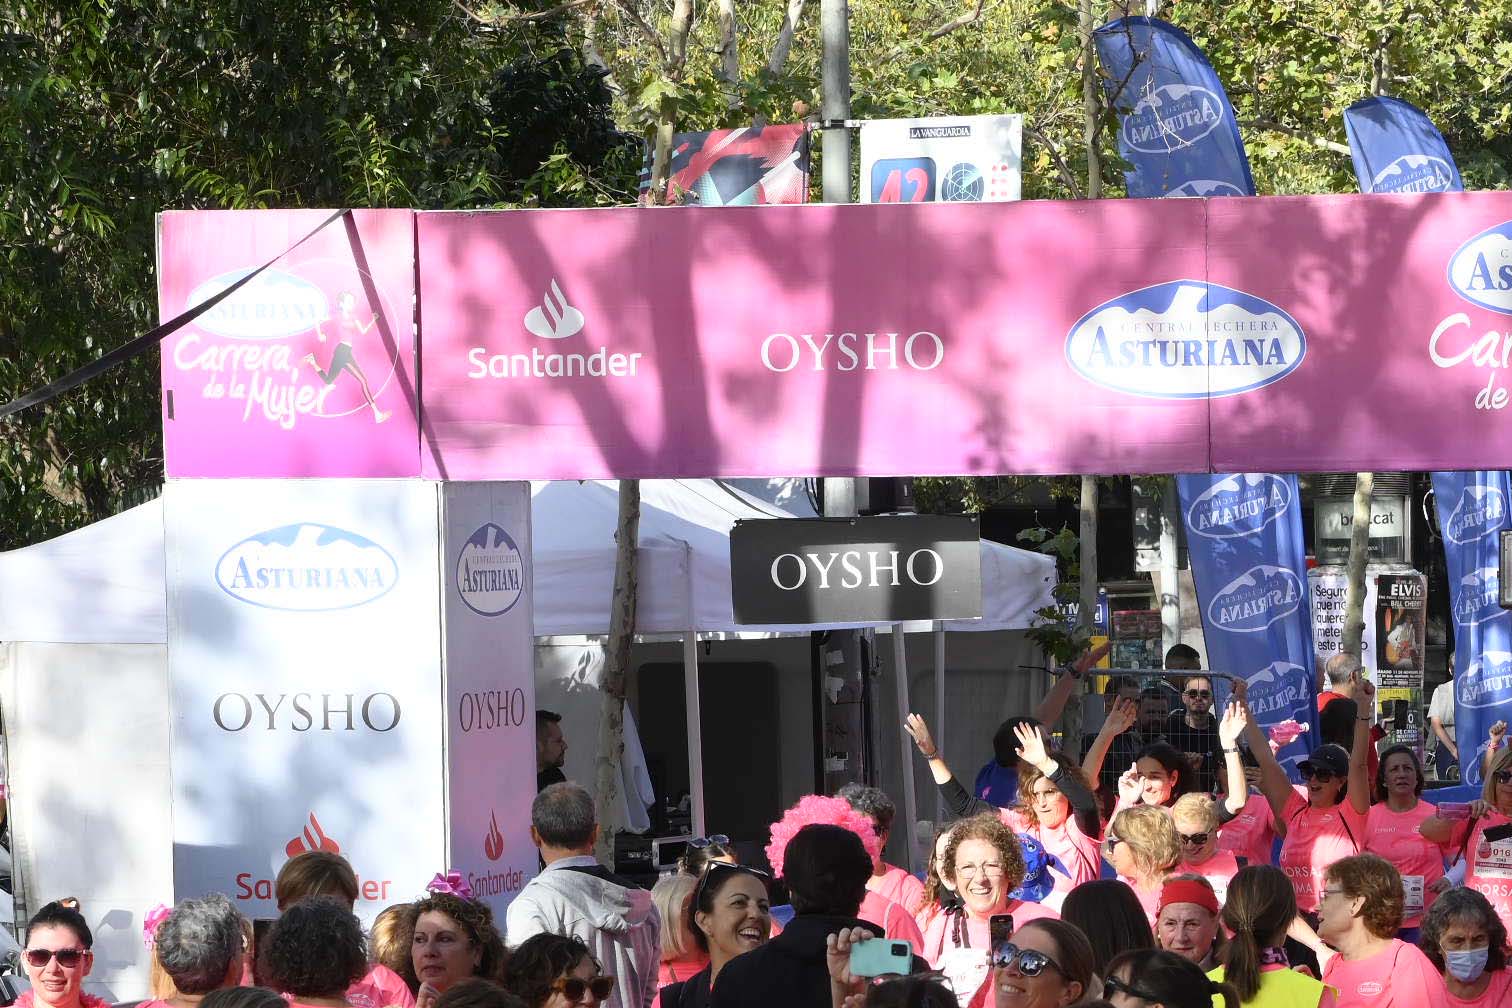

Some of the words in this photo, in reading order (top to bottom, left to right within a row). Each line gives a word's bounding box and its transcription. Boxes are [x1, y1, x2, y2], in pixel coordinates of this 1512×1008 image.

[921, 126, 970, 137] VANGUARDIA
[174, 333, 292, 373] Carrera
[467, 347, 643, 379] Santander
[760, 331, 945, 373] OYSHO
[1085, 326, 1287, 369] ASTURIANA
[202, 373, 228, 399] de
[230, 373, 246, 399] la
[243, 368, 336, 430] Mujer
[1474, 371, 1510, 410] de
[230, 556, 385, 590] ASTURIANA
[462, 557, 521, 594] ASTURIANA
[770, 548, 944, 591] OYSHO
[1316, 601, 1333, 612] que
[1390, 584, 1422, 597] ELVIS
[1317, 640, 1337, 651] este
[212, 692, 402, 732] OYSHO
[459, 688, 526, 732] OYSHO
[1492, 847, 1511, 858] 016
[468, 868, 524, 900] Santander
